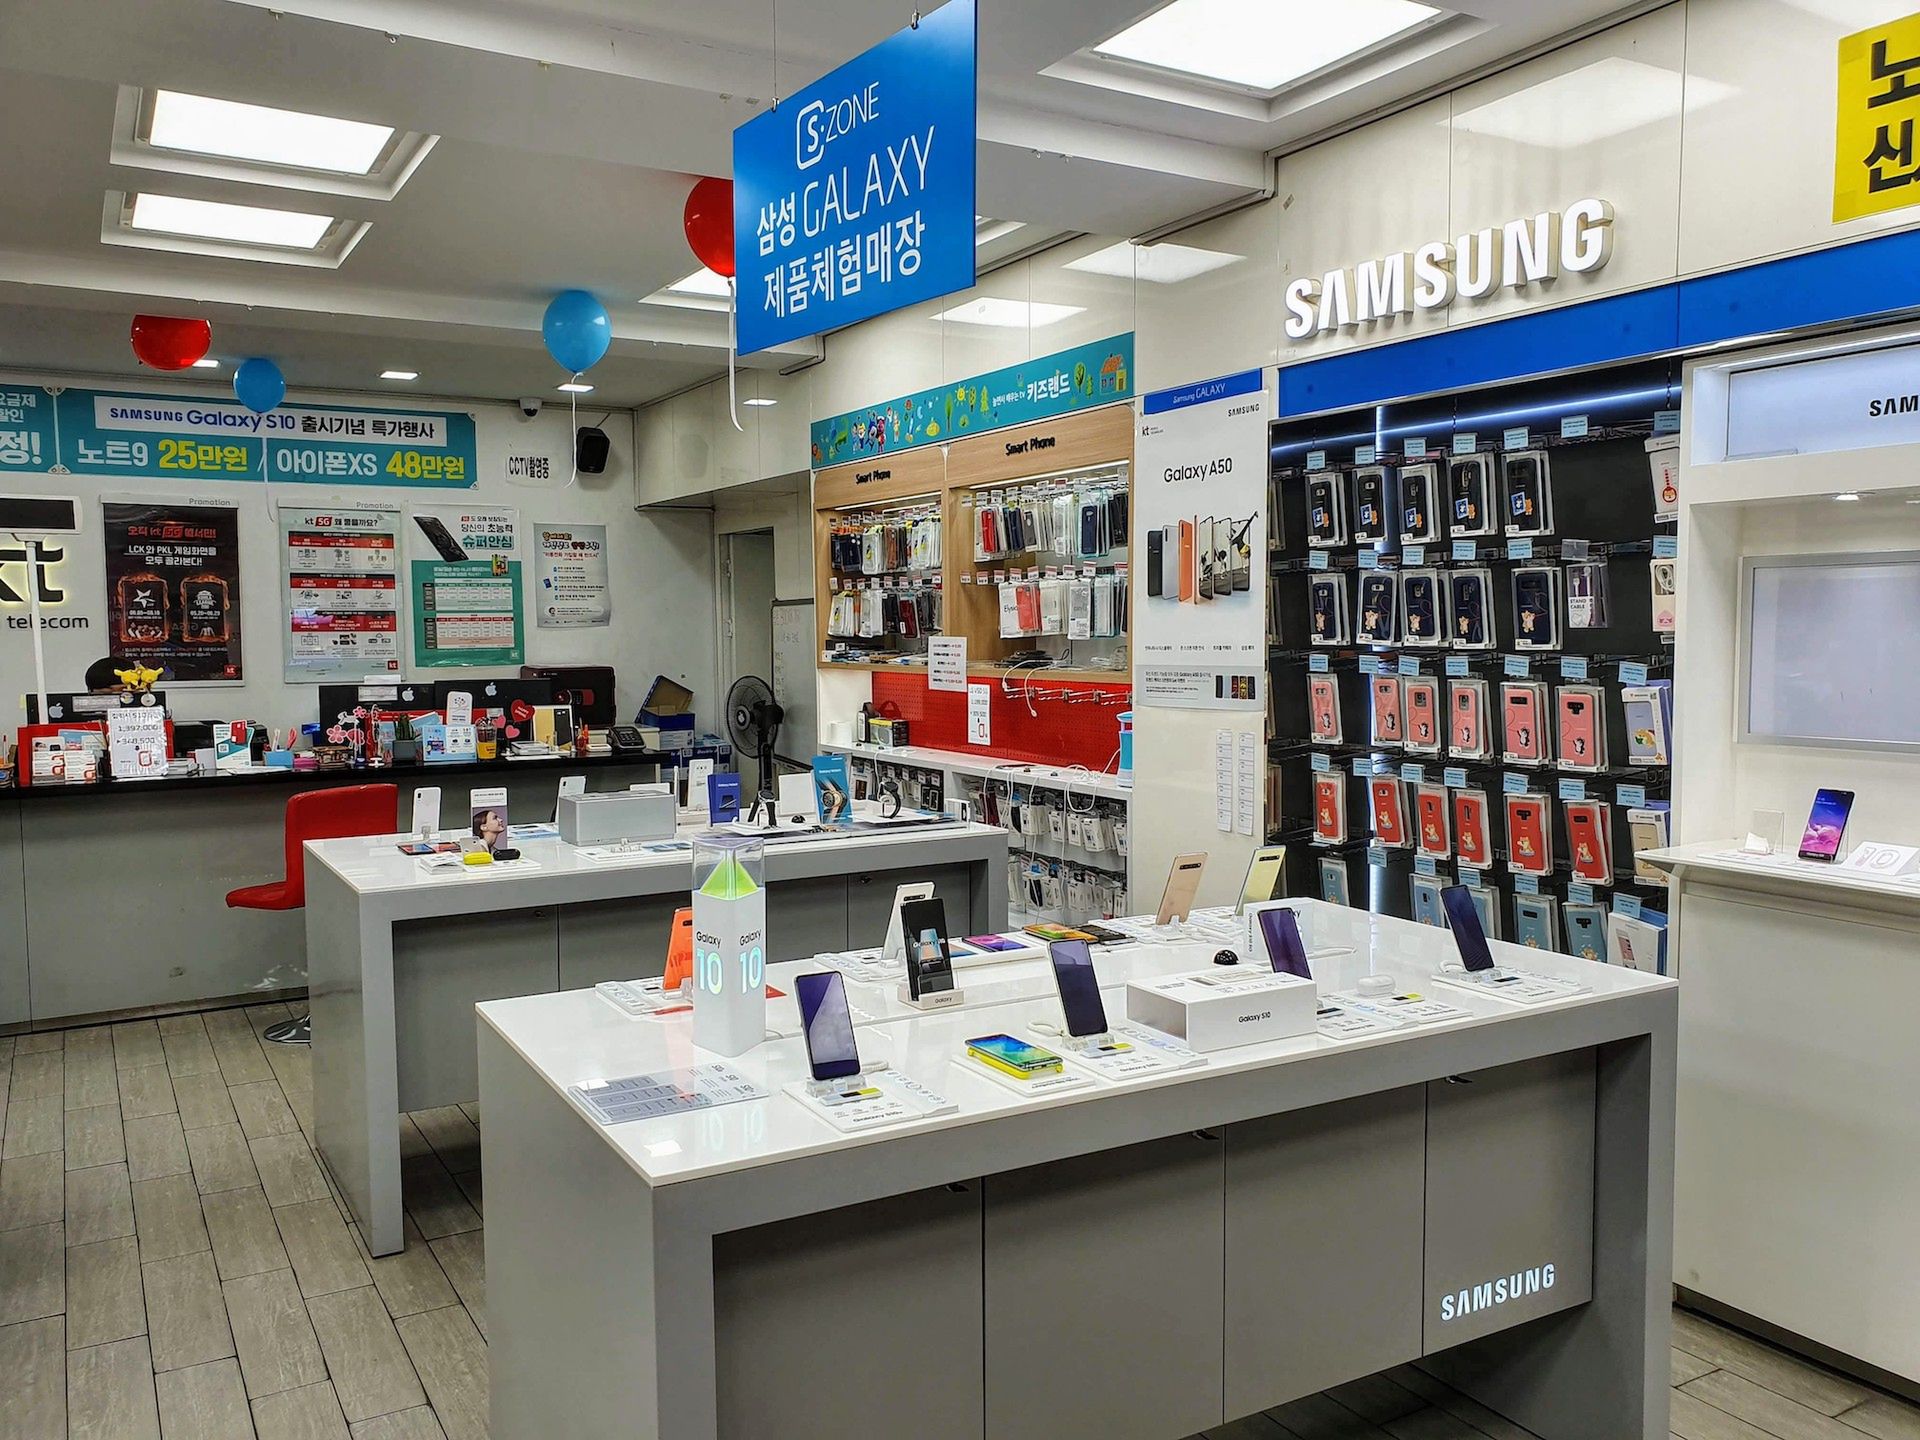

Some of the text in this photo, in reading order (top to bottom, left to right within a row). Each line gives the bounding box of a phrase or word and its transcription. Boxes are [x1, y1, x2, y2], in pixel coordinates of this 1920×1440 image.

[826, 81, 880, 143] ZONE
[1863, 118, 1920, 193] 신
[757, 125, 935, 257] 삼성 GALAXY
[764, 209, 926, 319] 제품체험매장
[1284, 198, 1613, 339] SAMSUNG
[1027, 373, 1070, 403] 키즈랜드
[1172, 382, 1227, 404] Samsung GALAXY
[1228, 403, 1260, 417] SAMSUNG
[1869, 394, 1919, 417] SAM
[110, 407, 434, 439] SAMSUNG Galaxy S10 출시기념 특가행사
[1005, 436, 1056, 456] Smart Phone
[77, 438, 149, 467] 노트9
[158, 438, 248, 472] 25만원
[276, 448, 377, 477] 아이폰XS
[386, 450, 465, 480] 48만원
[509, 456, 549, 480] CCTV촬영중
[1163, 457, 1233, 482] Galaxy A50
[855, 469, 891, 485] Smart Phone
[188, 497, 231, 506] Promotion
[356, 501, 394, 510] Promotion
[304, 517, 314, 525] kt
[317, 517, 331, 525] 5G
[461, 523, 485, 533] 당신의
[128, 545, 145, 553] LCK
[156, 545, 173, 554] PKL
[462, 534, 514, 549] 슈퍼안심
[7, 614, 89, 629] telecom
[389, 661, 398, 669] kt
[696, 931, 721, 949] Galaxy
[740, 929, 762, 946] Galaxy
[696, 948, 723, 995] 10
[739, 946, 762, 994] 10
[1238, 1011, 1271, 1023] Galaxy S10
[1441, 1263, 1555, 1321] SAMSUNG
